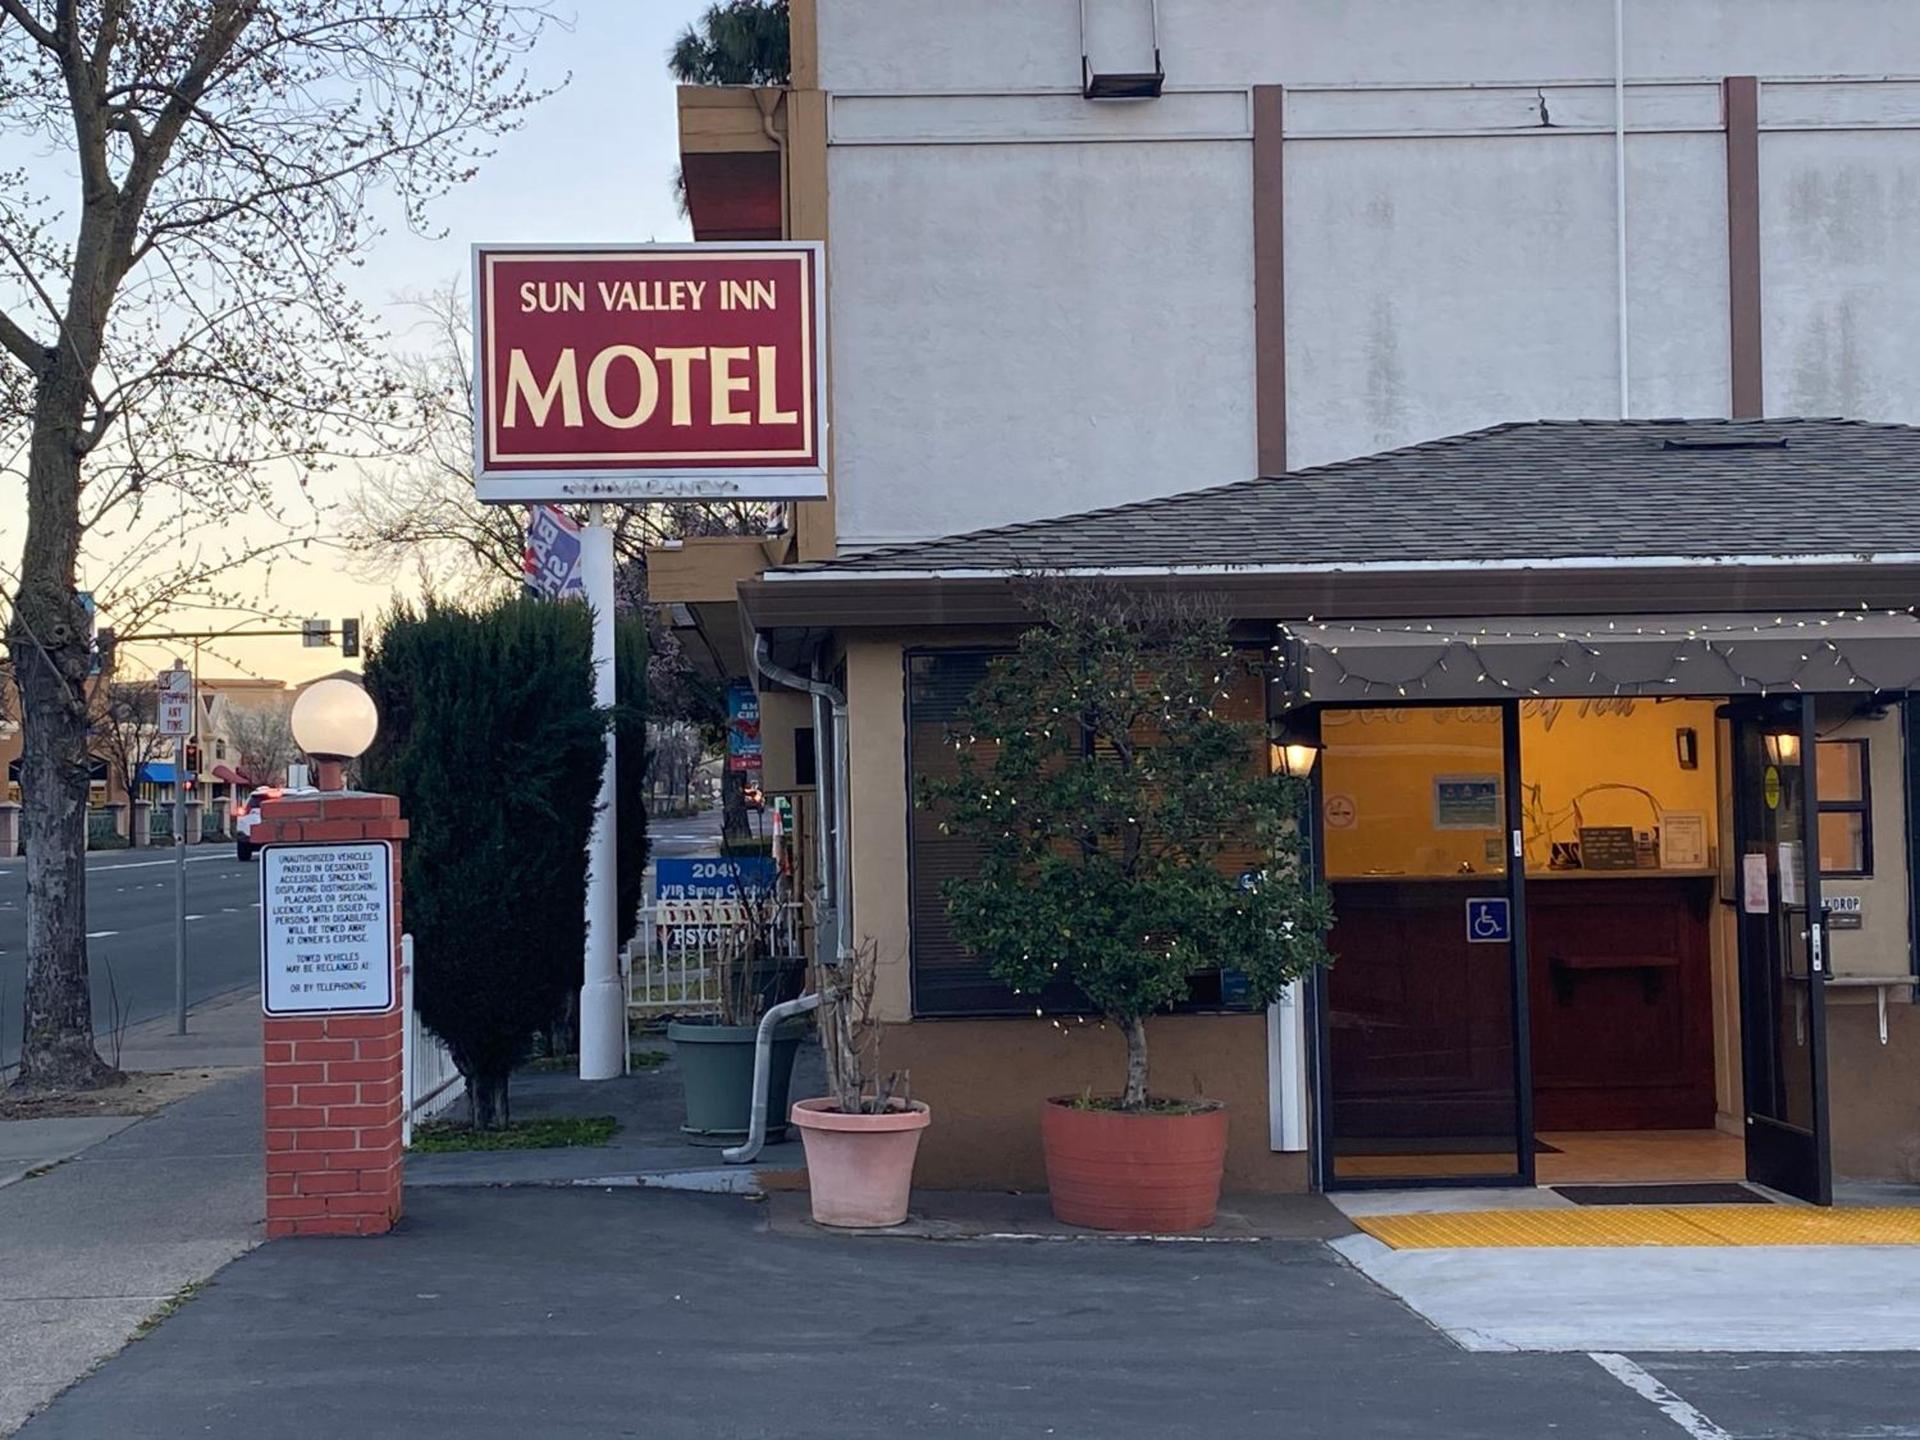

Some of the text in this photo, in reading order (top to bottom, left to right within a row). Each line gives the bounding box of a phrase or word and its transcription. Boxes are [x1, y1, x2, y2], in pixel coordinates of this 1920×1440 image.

[520, 279, 776, 313] SUN VALLEY INN
[502, 345, 798, 429] MOTEL
[279, 852, 373, 863] UNAUTHORIZED VEHICLES
[283, 864, 311, 873] PARKED
[325, 862, 370, 872] DESIGNATED
[280, 872, 372, 883] ACCESSIBLE SPACES NOT
[275, 883, 377, 894] DISPLAYING DISTINGUISHING
[284, 893, 367, 904] PLACARDS OR SPECIAL
[1833, 897, 1860, 910] DROP
[273, 902, 380, 915] LICENSE PLATES ISSUED FOR
[275, 913, 379, 925] PERSONS WITH DISABILITIES
[288, 924, 367, 934] WILL BE TOWED AWAY
[286, 936, 294, 945] AT
[297, 934, 330, 944] OWNER'S
[296, 952, 359, 963] TOWED VEHICLES
[286, 961, 368, 973] MAY BE RECLAIMED AT
[290, 981, 367, 993] OR BY TELEPHONING
